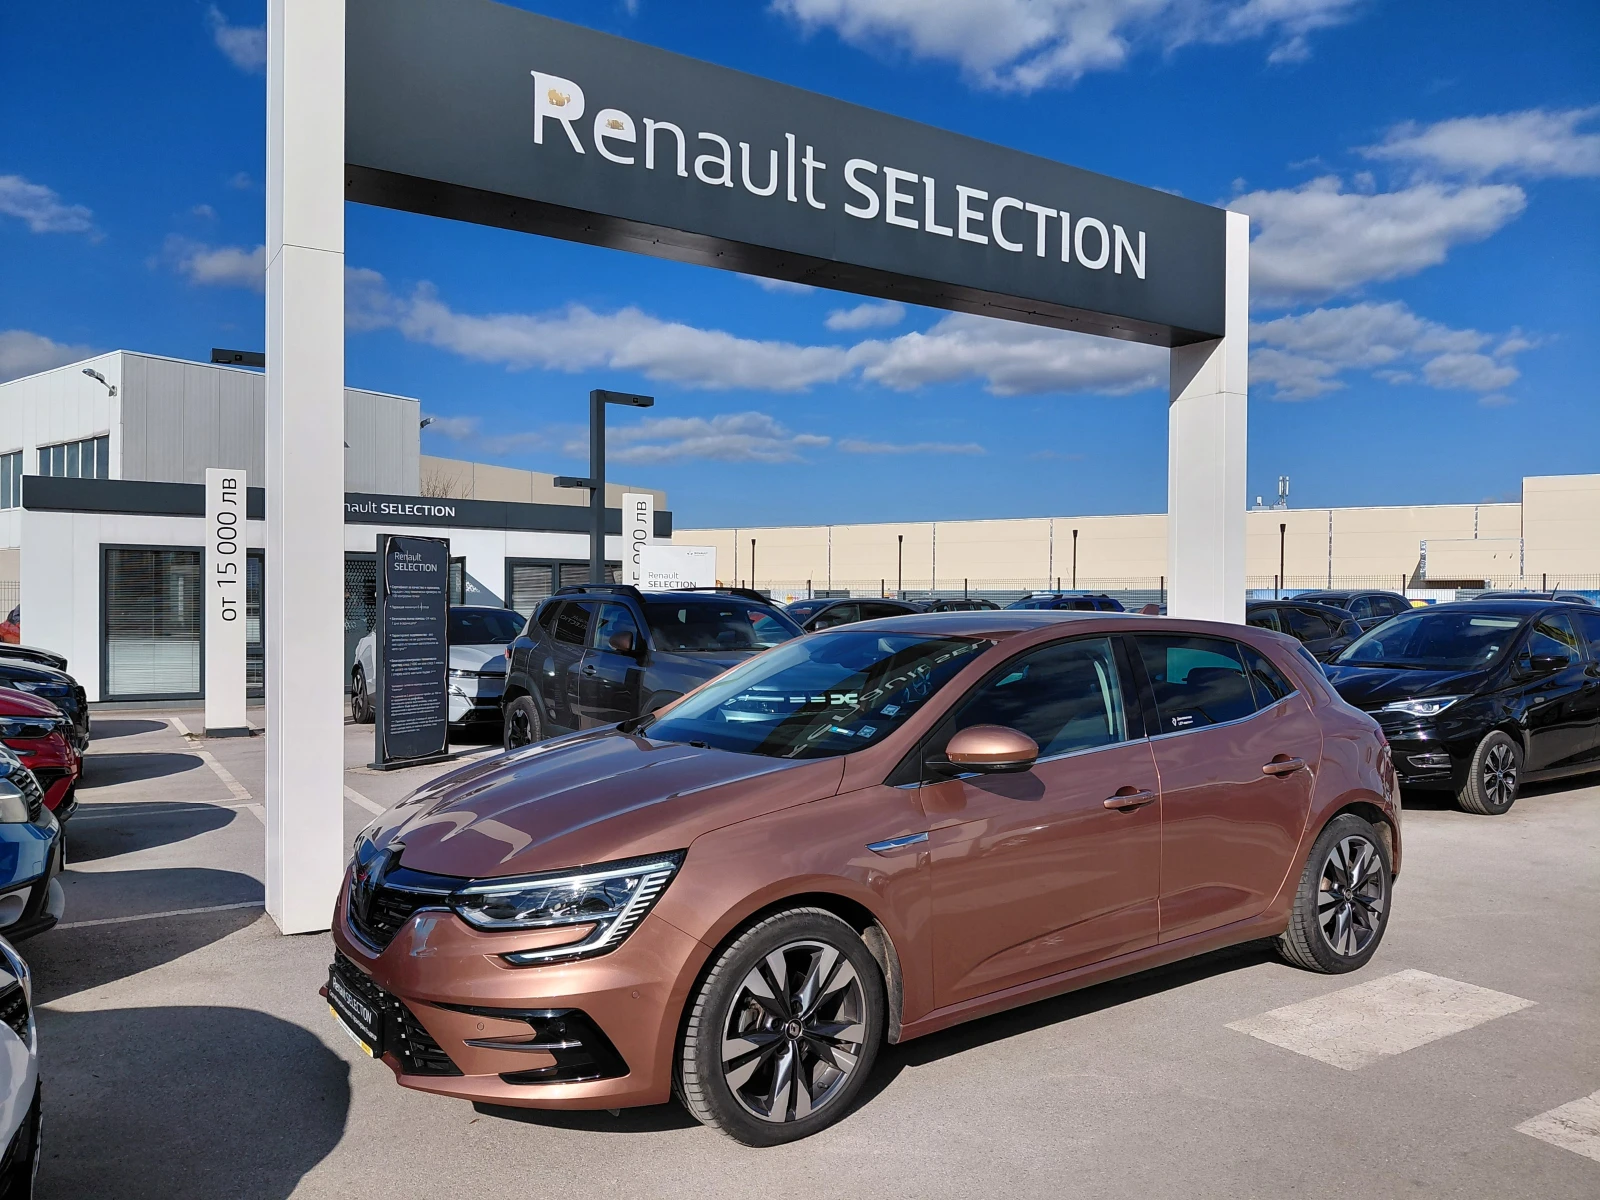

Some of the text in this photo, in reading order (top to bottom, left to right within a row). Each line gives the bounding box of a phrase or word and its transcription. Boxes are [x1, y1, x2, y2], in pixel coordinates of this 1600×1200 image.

[530, 70, 1147, 280] Renault SELECTION
[344, 500, 456, 517] nault SELECTION
[636, 501, 647, 524] лв
[216, 478, 237, 622] от 15 000 лв
[394, 551, 422, 562] Renault
[394, 562, 438, 572] SELECTION
[648, 571, 679, 580] Renault
[648, 580, 697, 588] SELECTION
